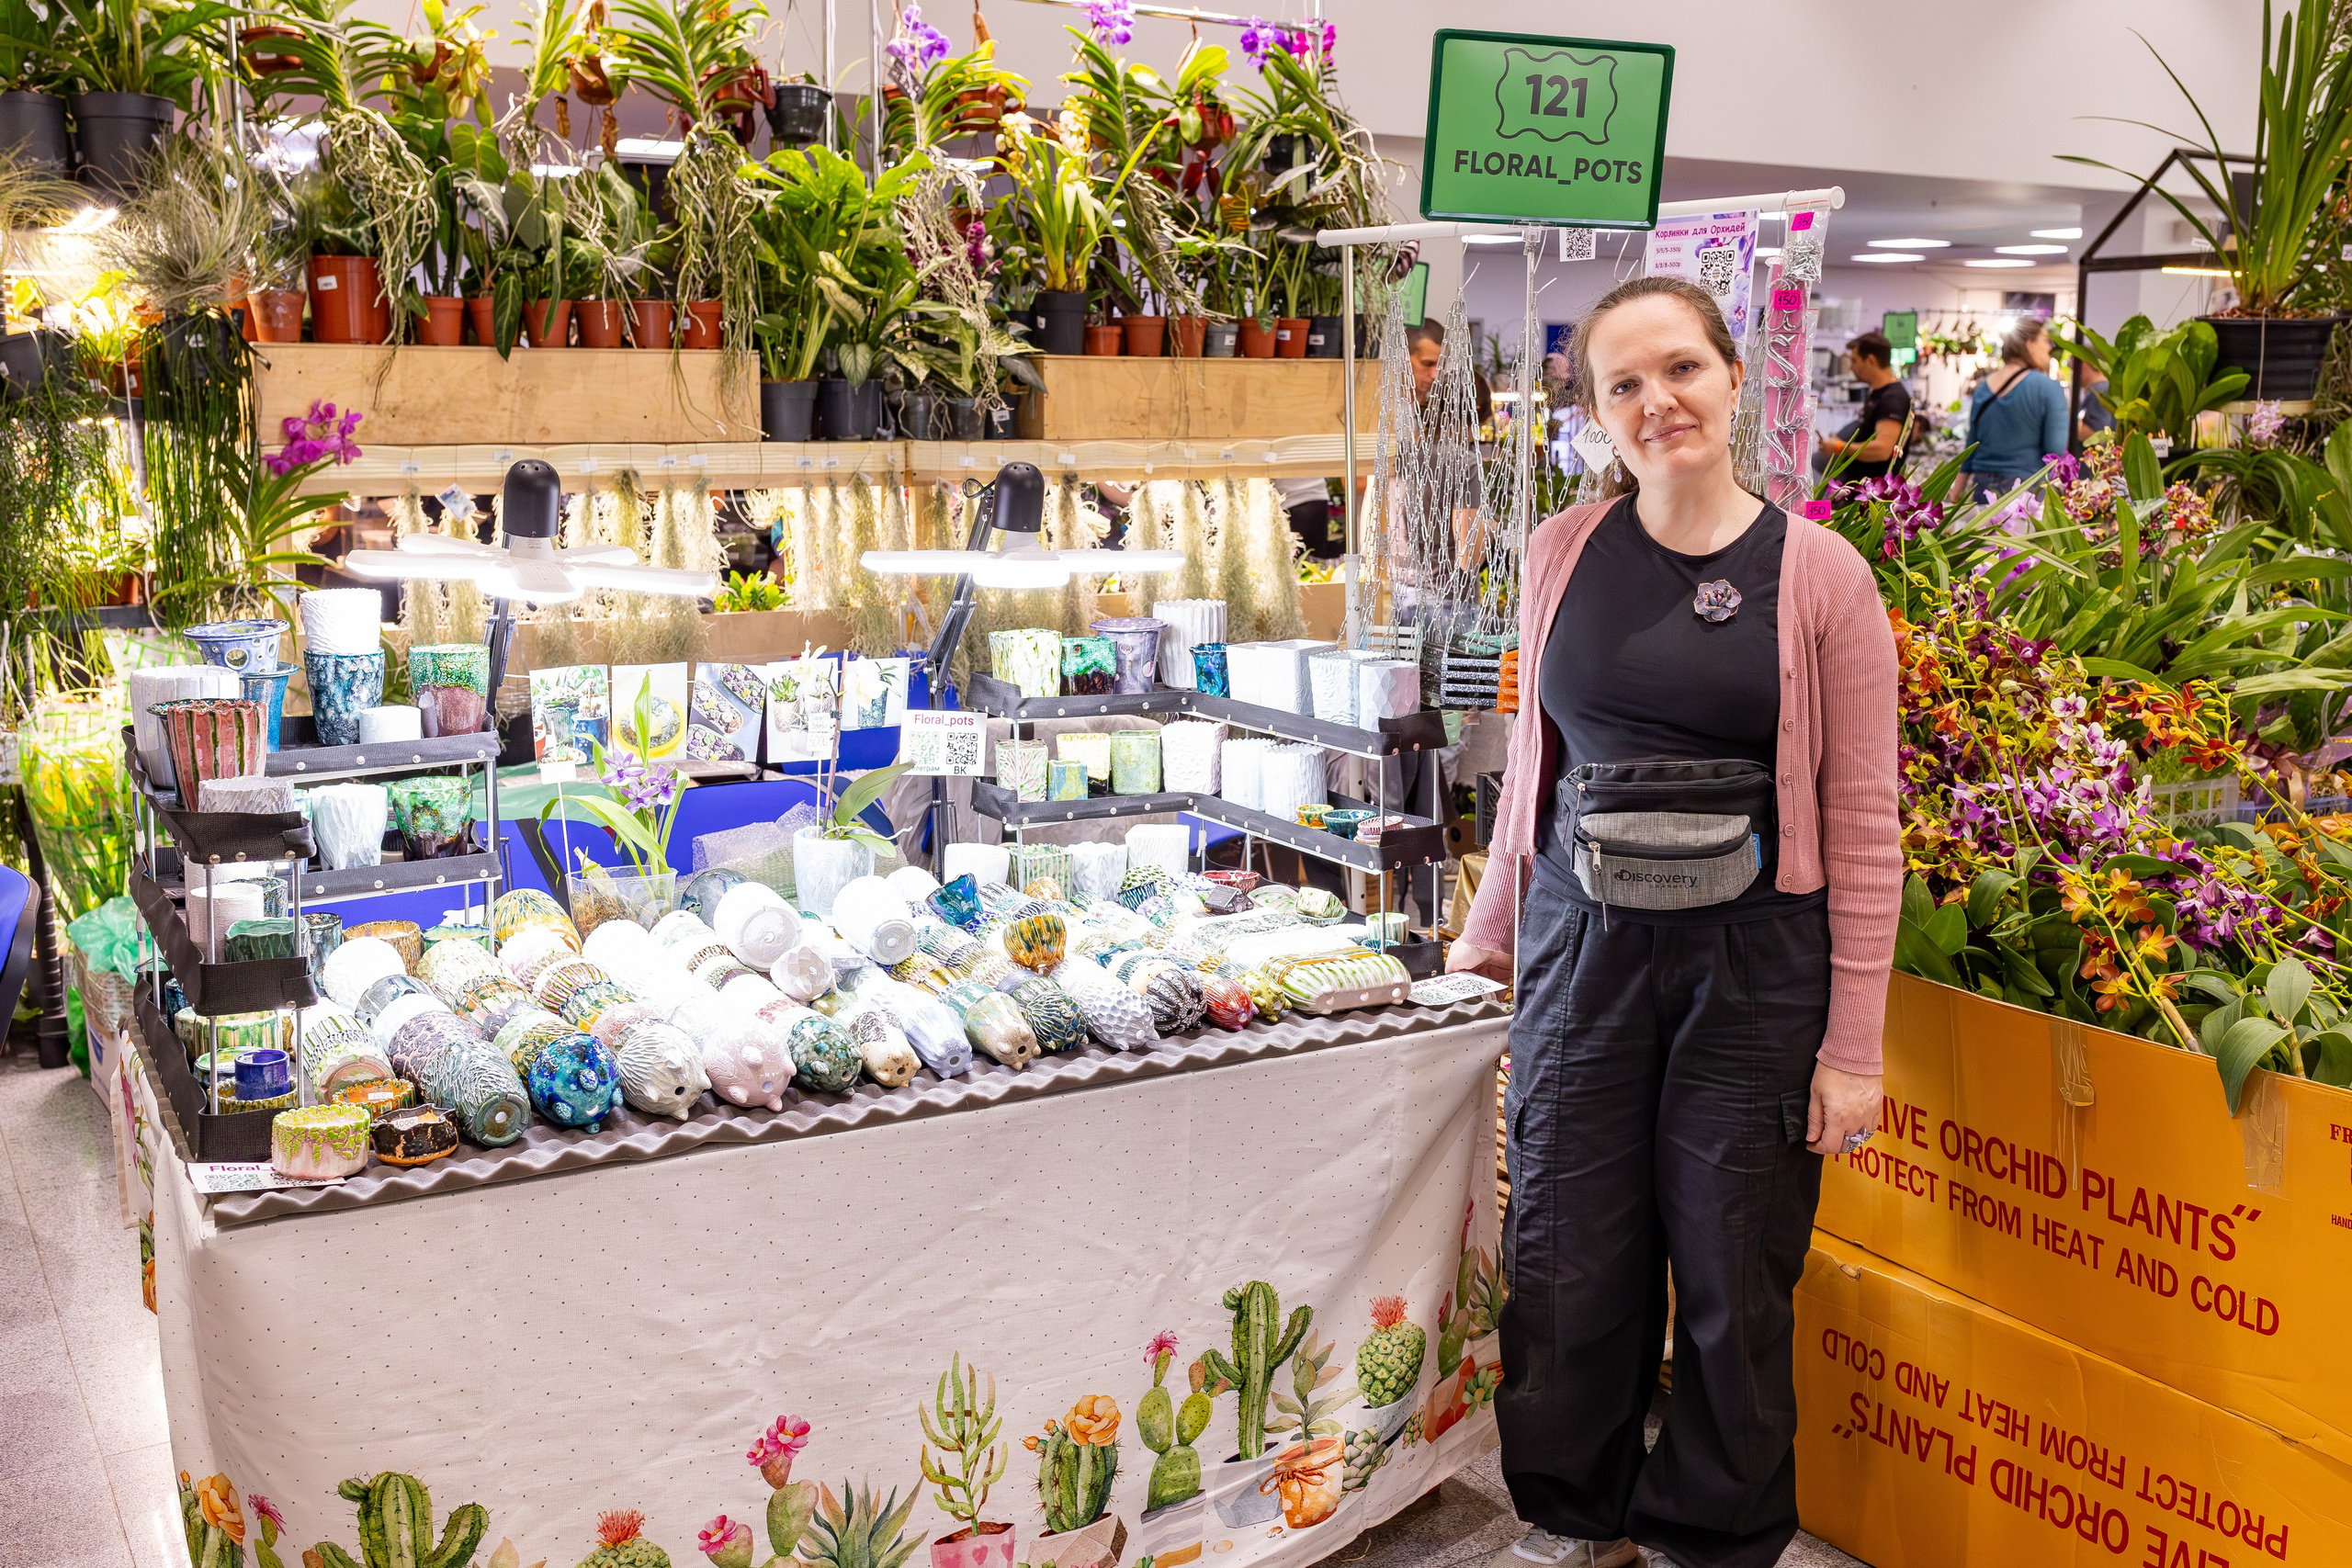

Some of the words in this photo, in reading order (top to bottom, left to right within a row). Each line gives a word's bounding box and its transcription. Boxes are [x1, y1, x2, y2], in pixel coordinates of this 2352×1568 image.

[1525, 73, 1589, 118] 121
[1453, 149, 1643, 186] FLORAL_POTS
[1655, 229, 1690, 240] Корзинки
[1691, 227, 1708, 236] для
[1710, 221, 1746, 234] Орхидей
[1778, 294, 1797, 306] 150
[1809, 505, 1826, 516] 150
[914, 713, 975, 728] Floral_pots
[911, 764, 941, 773] елеграм
[1614, 868, 1698, 888] Discovery
[1939, 1119, 2068, 1200] ORCHID
[1948, 1179, 2022, 1240] FROM
[2031, 1213, 2105, 1270] HEAT
[2114, 1247, 2179, 1298] AND
[2189, 1274, 2280, 1337] COLD
[1821, 1327, 1886, 1382] COLD
[1894, 1360, 1951, 1409] AND
[1957, 1387, 2030, 1448] HEAT
[2039, 1421, 2127, 1491] FROM
[1989, 1458, 2130, 1555] ORCHID
[2135, 1465, 2290, 1562] PROTECT
